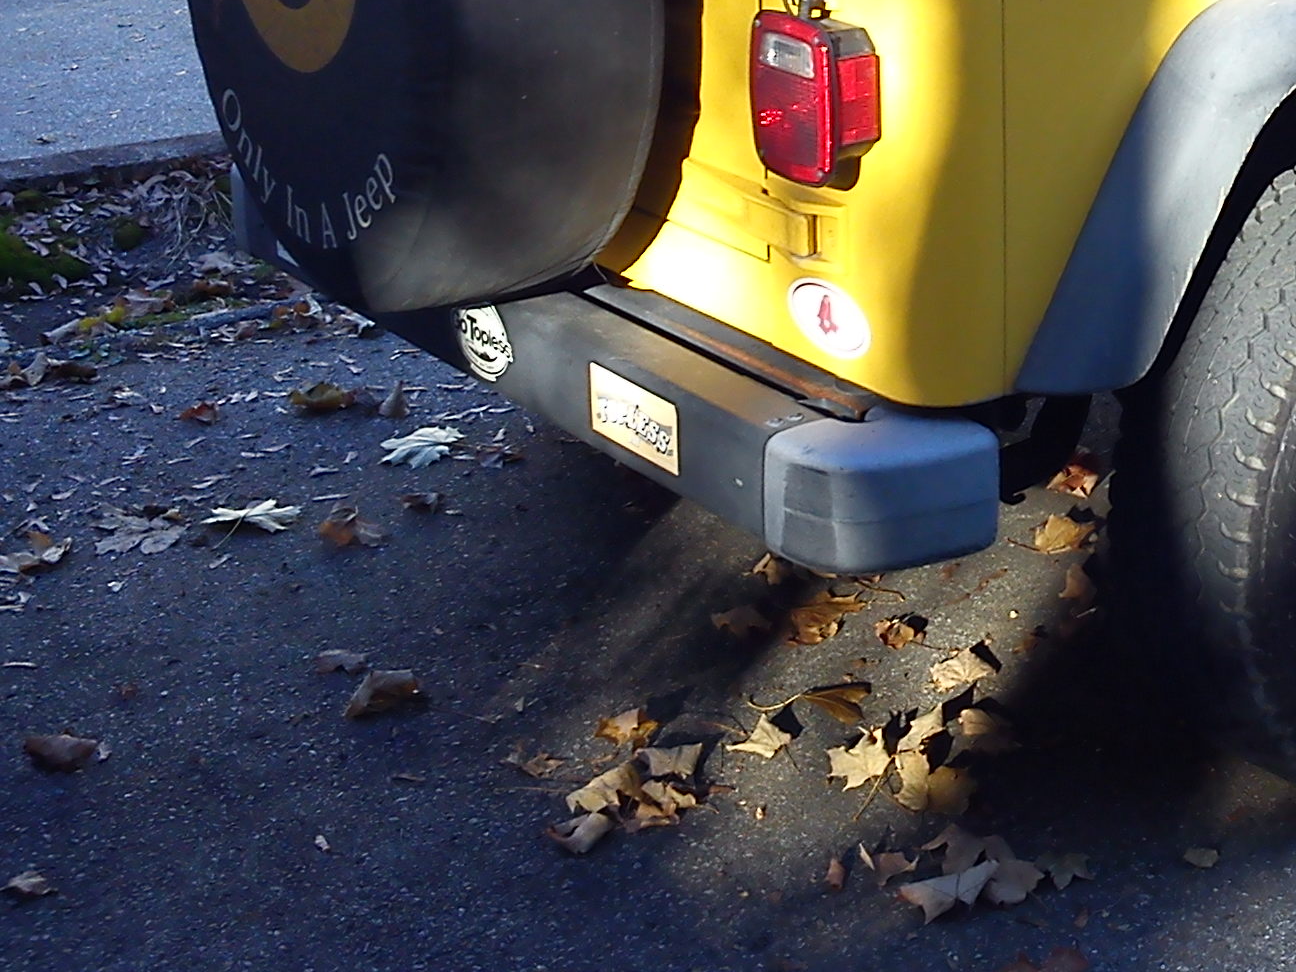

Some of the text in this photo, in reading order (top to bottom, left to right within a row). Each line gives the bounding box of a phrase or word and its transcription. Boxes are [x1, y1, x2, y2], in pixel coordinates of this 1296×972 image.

[222, 88, 397, 249] Only In A Jeep
[466, 314, 512, 359] Topless
